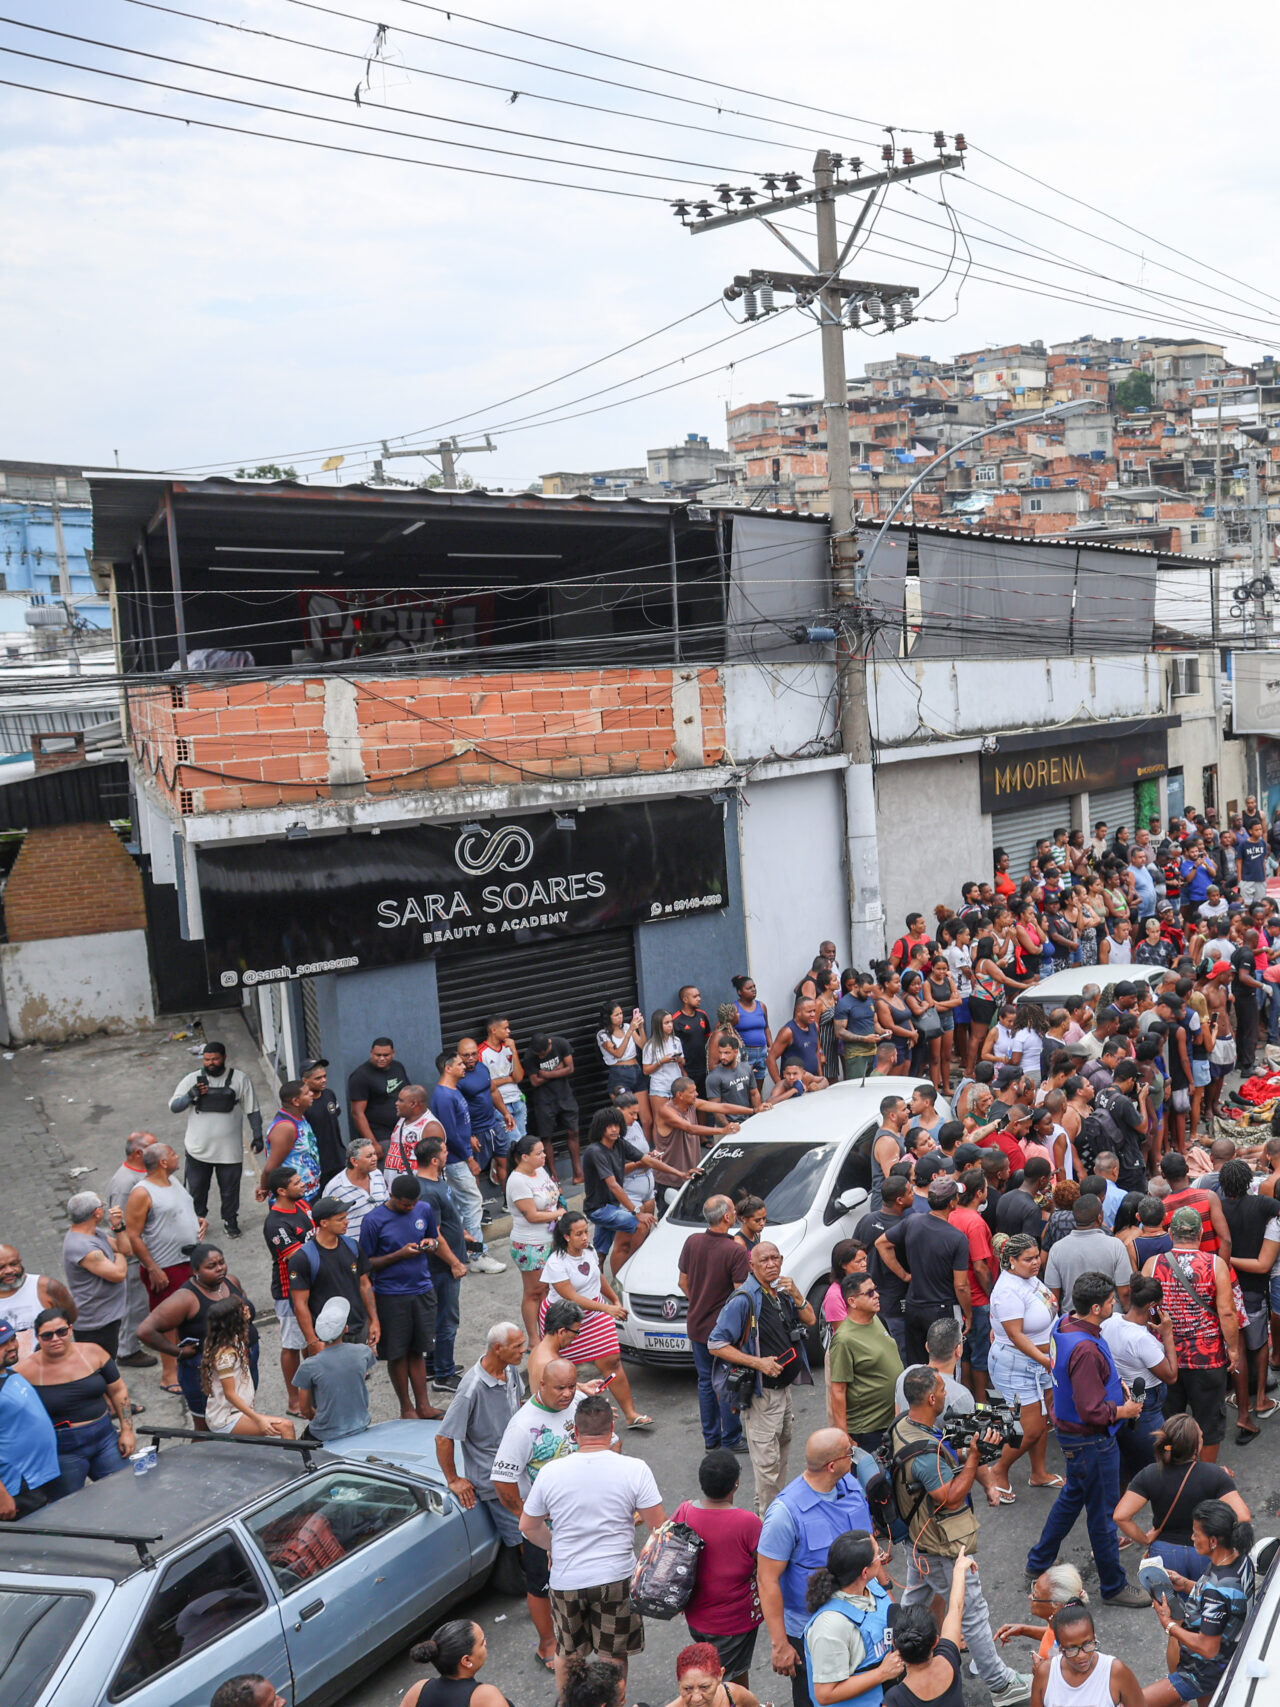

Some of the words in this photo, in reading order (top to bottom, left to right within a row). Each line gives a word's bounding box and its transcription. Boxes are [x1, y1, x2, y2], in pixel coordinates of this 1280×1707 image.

[377, 891, 472, 929] SARA
[482, 871, 606, 914] SOARES
[423, 924, 482, 945] BEAUTY
[486, 923, 496, 934] &
[500, 911, 569, 932] ACADEMY
[647, 1337, 686, 1350] LPN6C49
